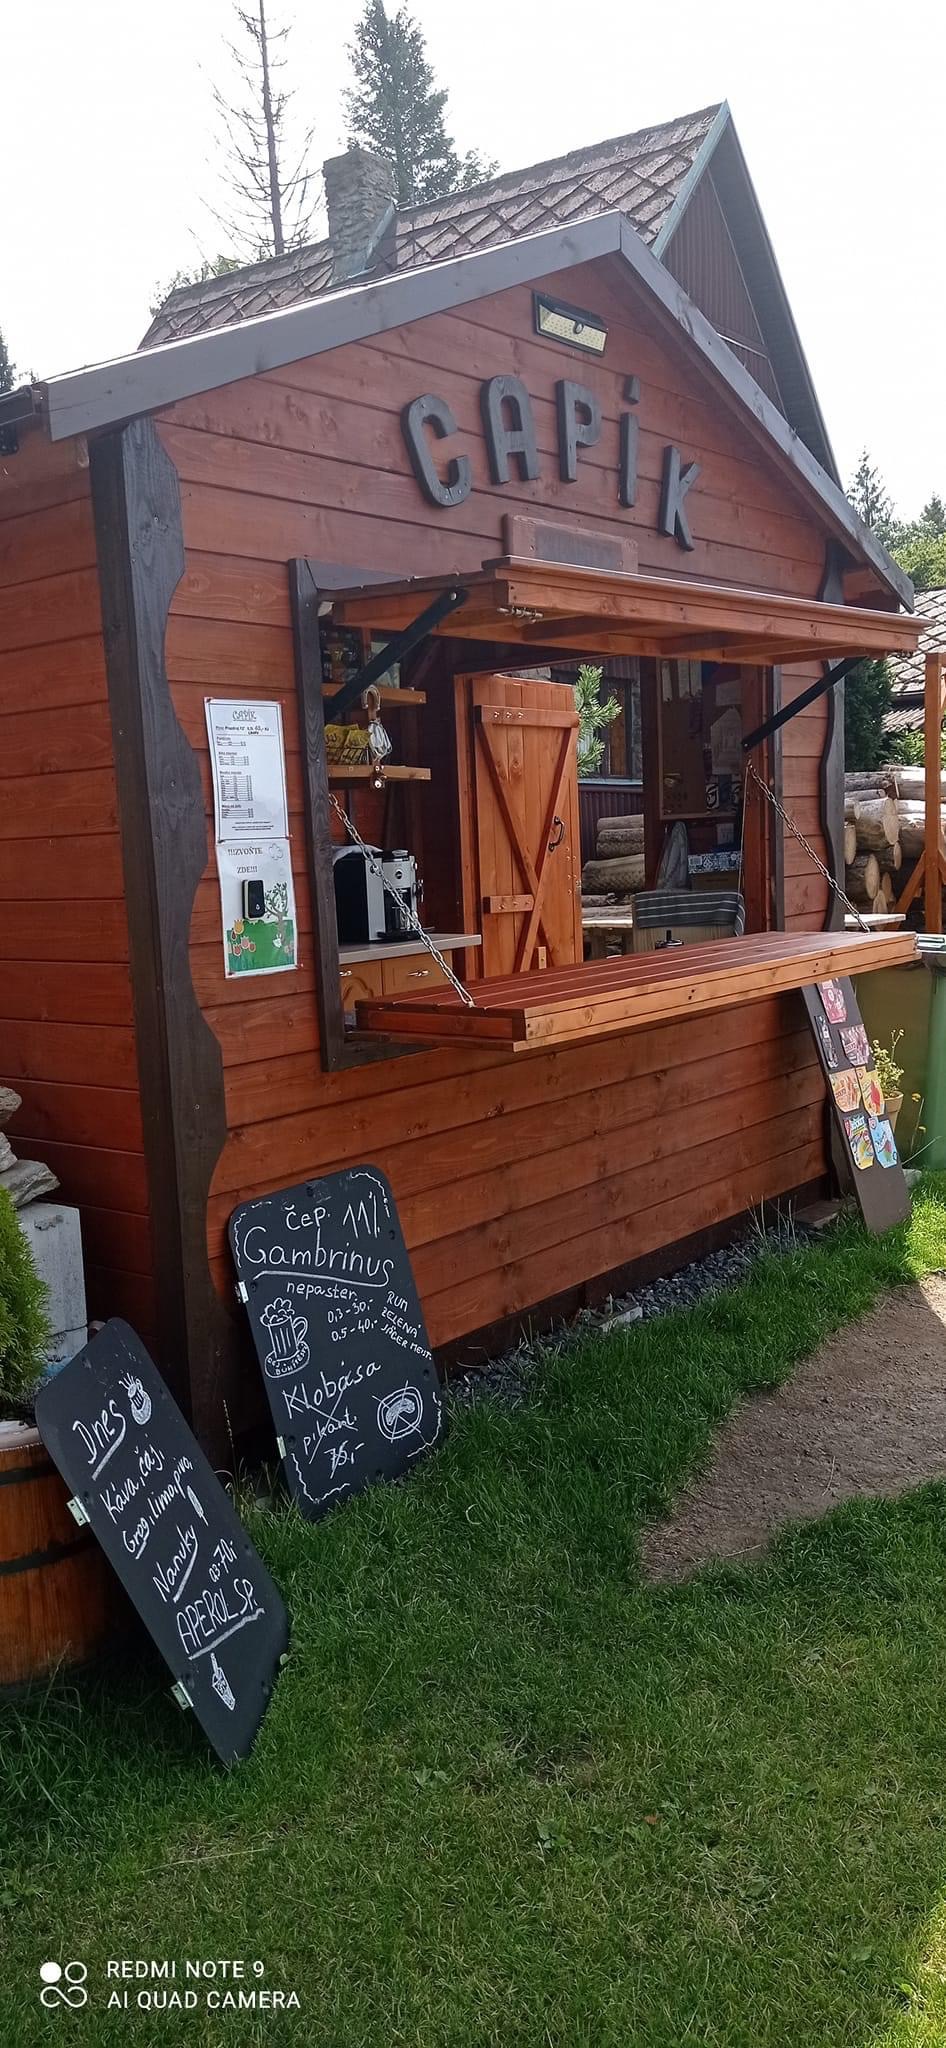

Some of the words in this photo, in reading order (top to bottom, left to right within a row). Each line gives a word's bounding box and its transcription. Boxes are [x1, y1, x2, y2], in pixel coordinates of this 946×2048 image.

[244, 1226, 394, 1282] Gambrinus
[72, 1399, 126, 1468] Dnes
[176, 1588, 238, 1655] APEROL
